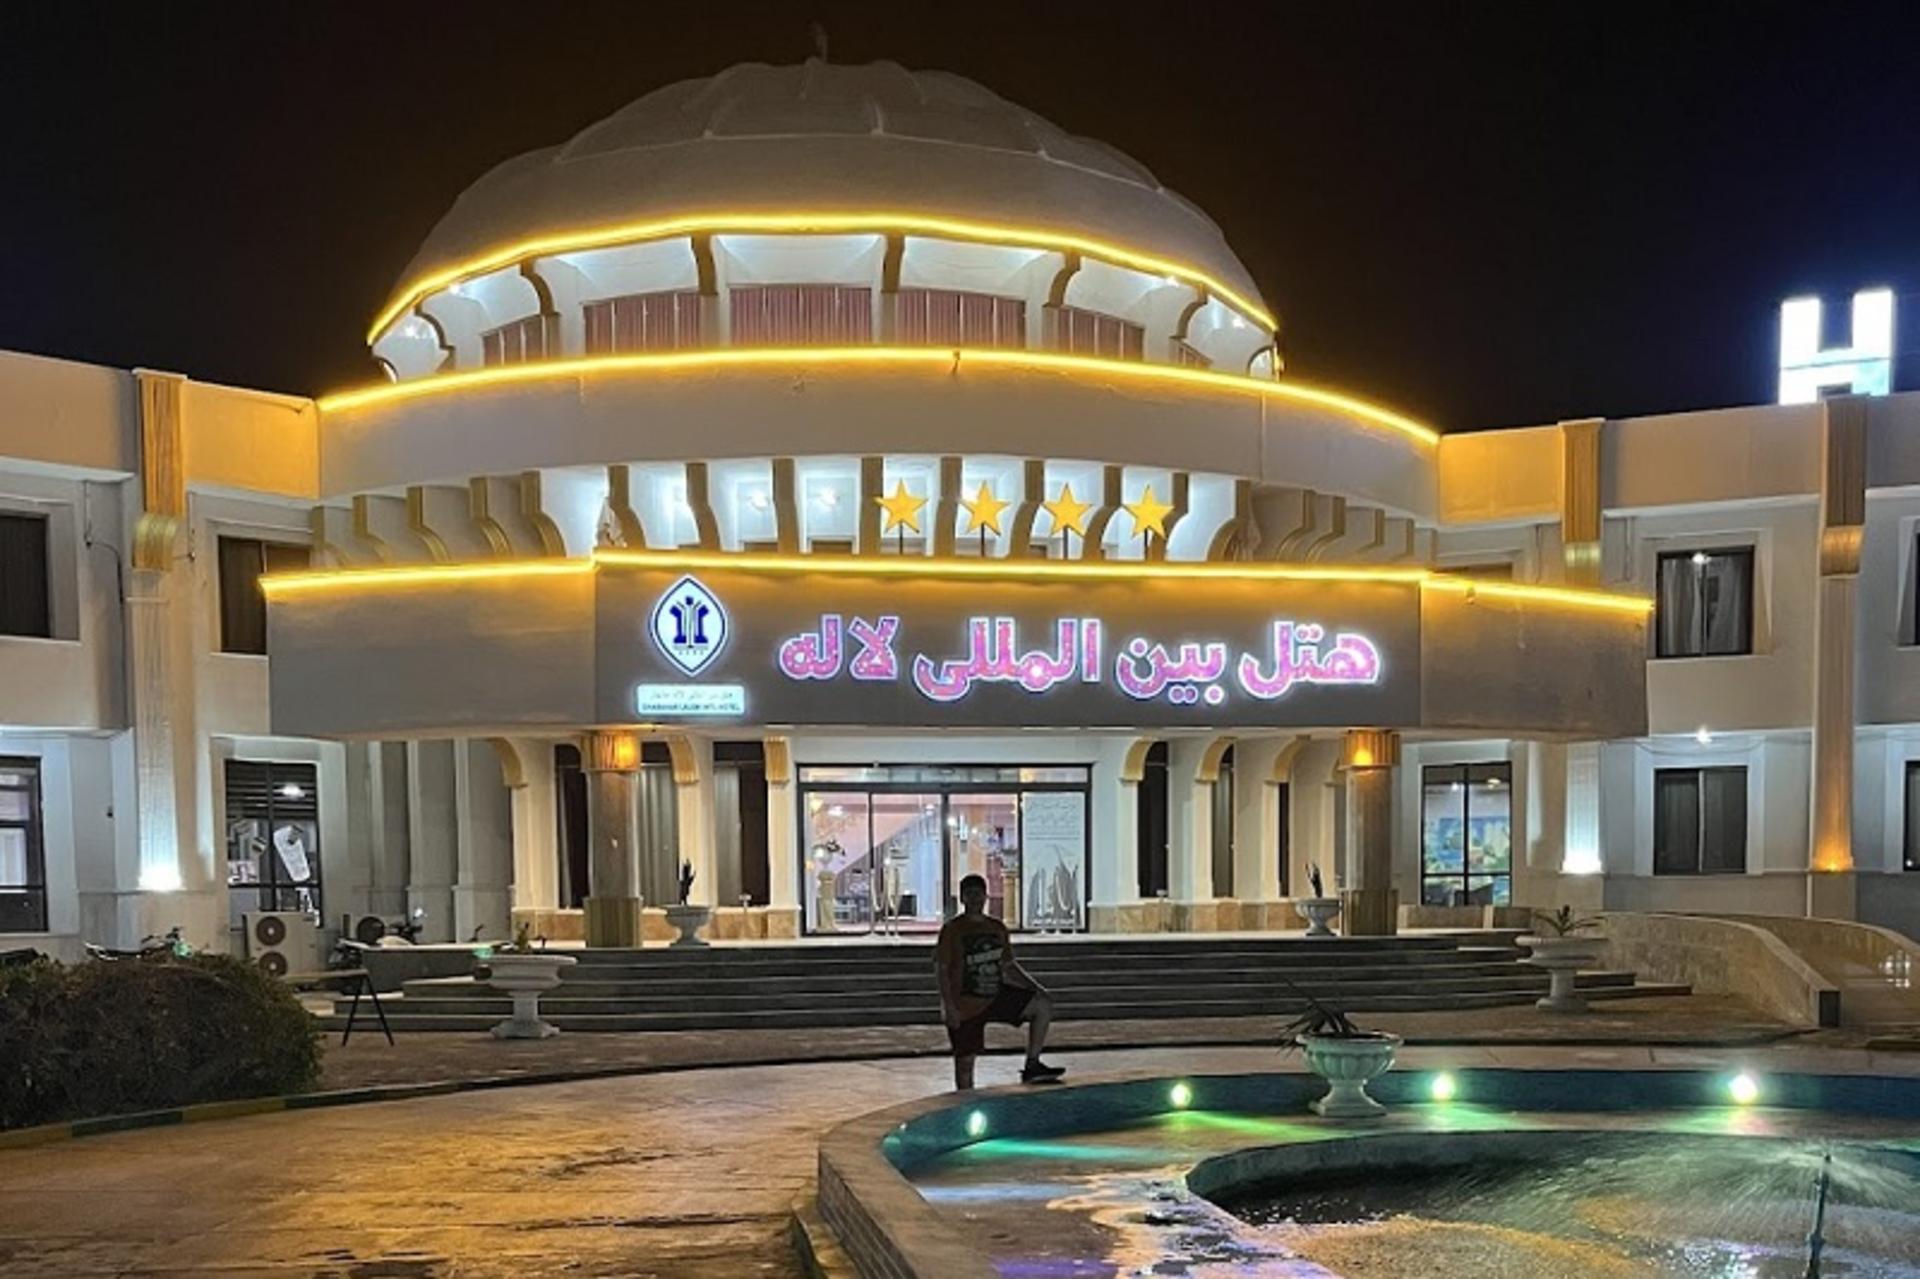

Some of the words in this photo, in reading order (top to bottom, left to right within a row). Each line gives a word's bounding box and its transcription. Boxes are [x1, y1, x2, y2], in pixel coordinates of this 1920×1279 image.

[1778, 287, 1893, 405] H
[779, 614, 899, 680] لاله
[913, 616, 1101, 701] المللی
[1116, 638, 1227, 705] بین
[1238, 619, 1382, 699] هتل
